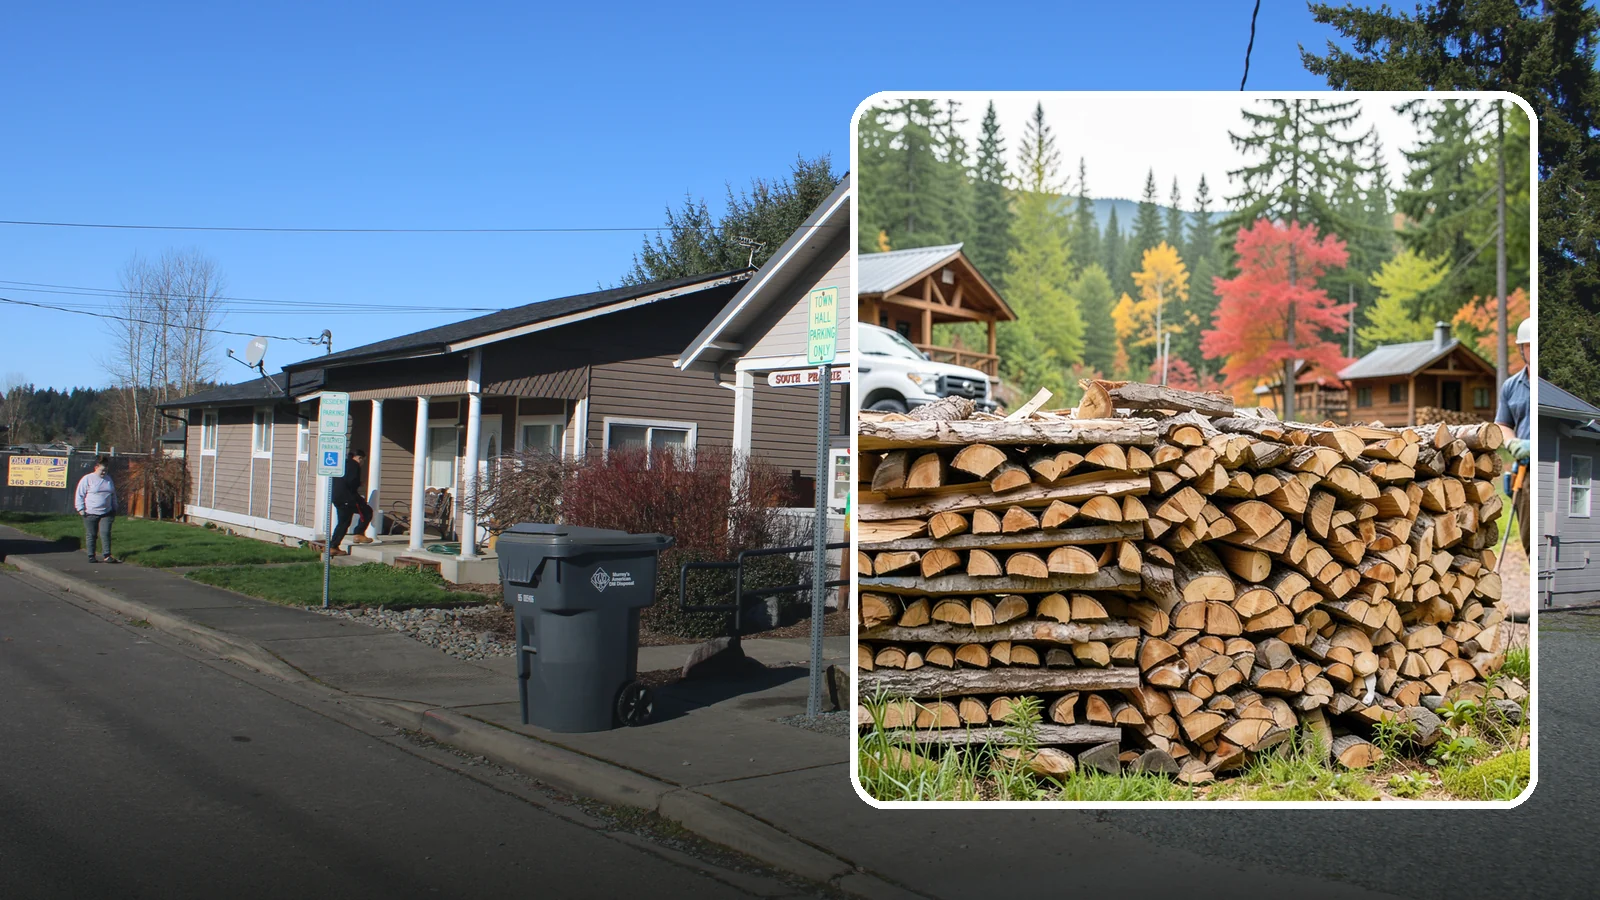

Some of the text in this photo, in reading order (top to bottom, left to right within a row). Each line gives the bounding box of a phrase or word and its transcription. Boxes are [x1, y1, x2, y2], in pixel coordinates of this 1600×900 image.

[815, 294, 833, 308] TOWN
[814, 312, 831, 324] HALL
[810, 326, 836, 341] PARKING
[813, 343, 831, 357] ONLY
[775, 373, 801, 384] SOUTH
[807, 370, 842, 383] PRRIE
[322, 409, 345, 417] PARKING
[325, 420, 340, 428] ONLY
[320, 436, 344, 444] RESERVED
[321, 443, 342, 452] PARKING
